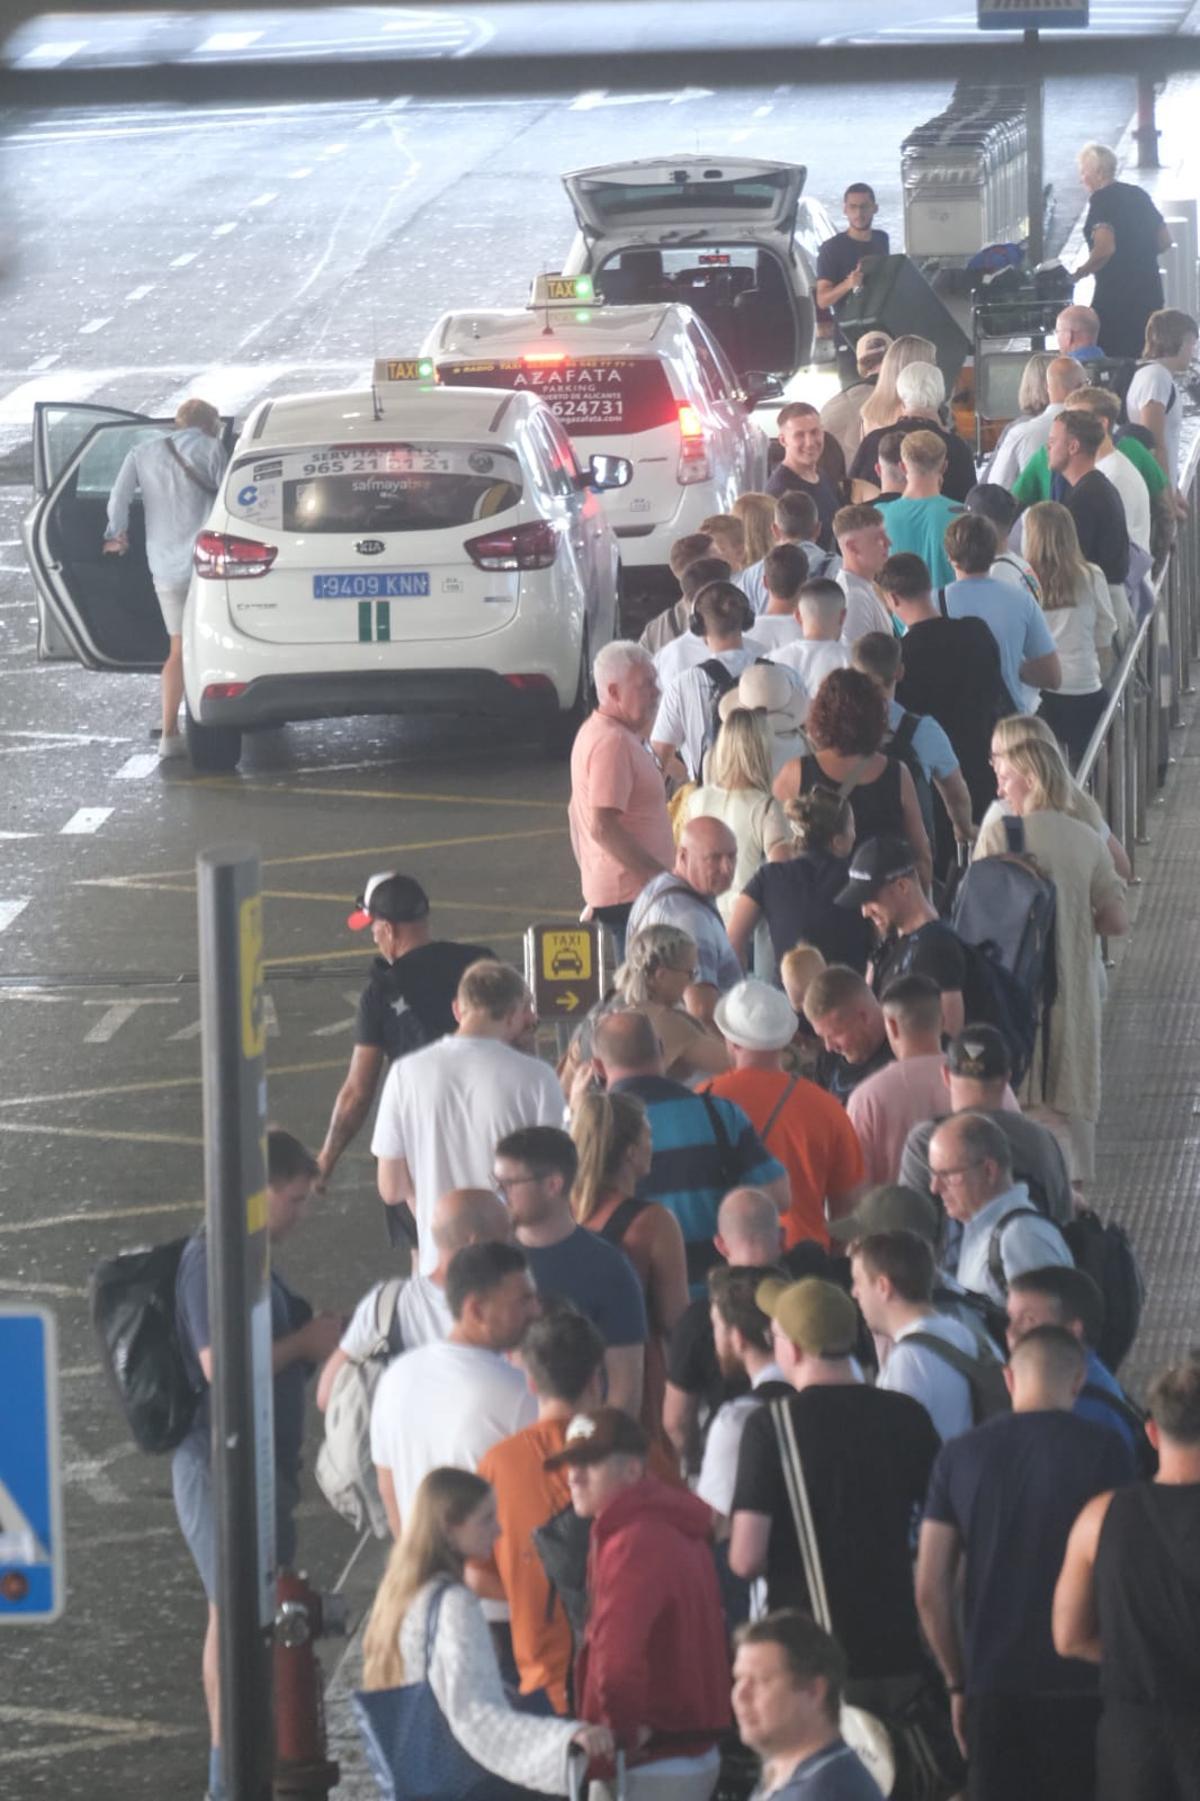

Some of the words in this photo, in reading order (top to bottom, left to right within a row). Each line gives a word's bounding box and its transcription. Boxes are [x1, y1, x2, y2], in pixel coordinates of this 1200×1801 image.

[548, 281, 578, 298] TAXI
[388, 361, 420, 380] TAXI
[513, 369, 622, 386] AZAFATA
[542, 384, 596, 393] PARKING
[583, 392, 622, 400] ALICANTE
[552, 400, 623, 416] 624731
[303, 461, 345, 477] 965
[353, 459, 378, 471] 21
[423, 459, 449, 471] 21
[327, 575, 380, 597] 9409
[385, 574, 427, 595] KNN
[553, 935, 582, 947] TAXI
